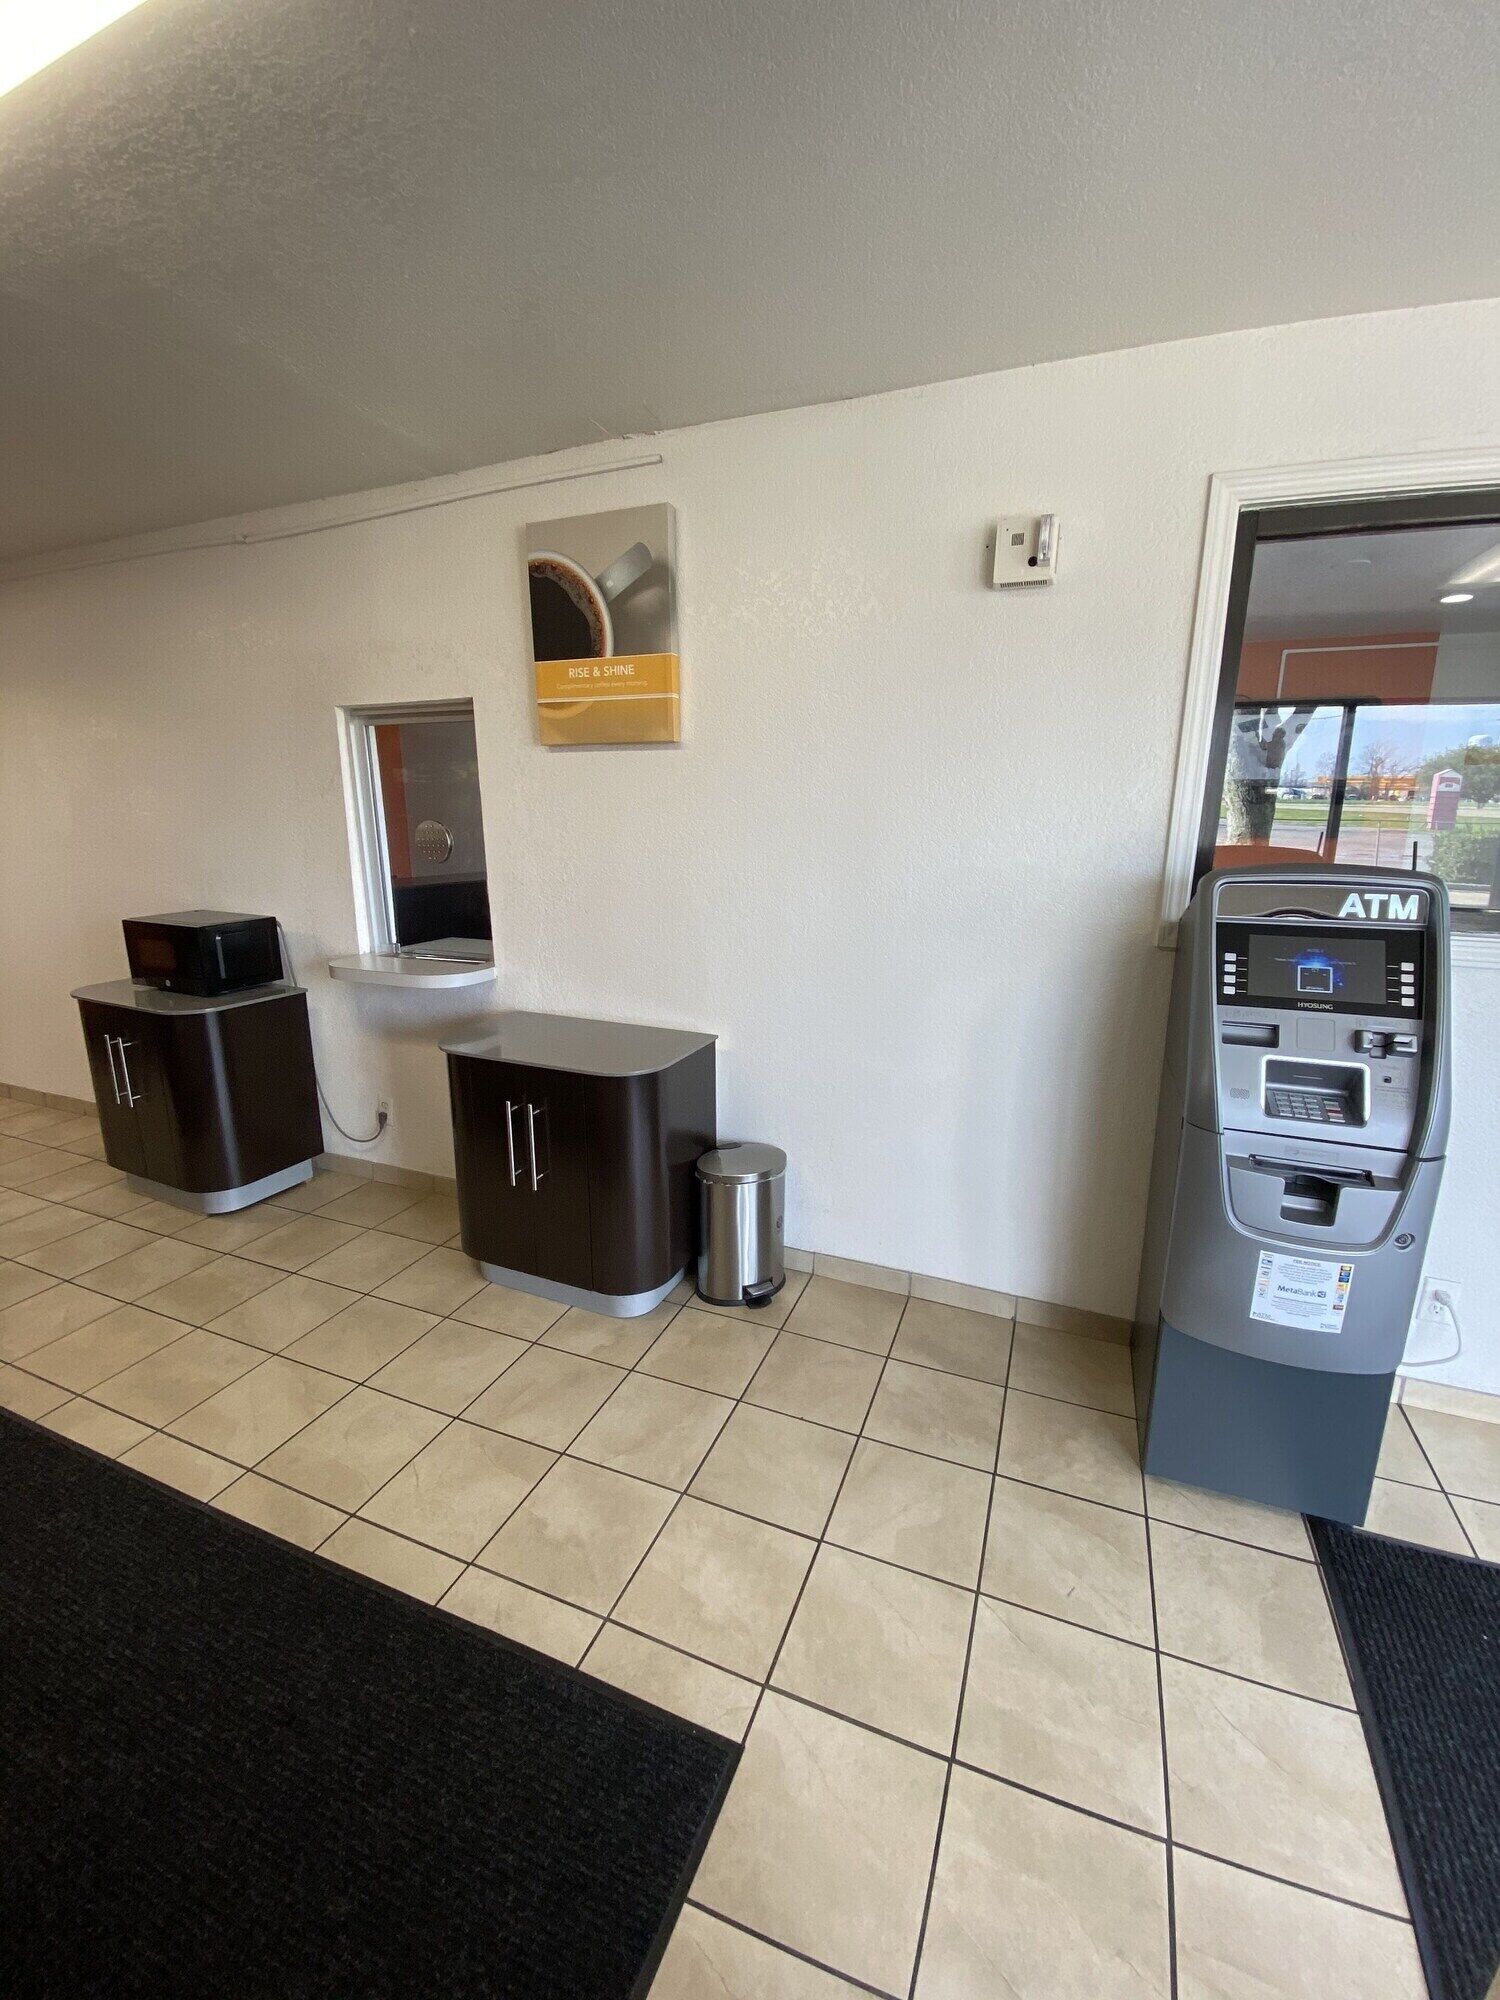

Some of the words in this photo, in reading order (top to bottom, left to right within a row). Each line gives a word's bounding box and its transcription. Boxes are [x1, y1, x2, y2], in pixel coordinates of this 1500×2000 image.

[568, 668, 590, 678] RISE
[593, 666, 601, 677] &
[603, 665, 634, 676] SHINE
[1337, 892, 1420, 920] ATM
[1297, 1001, 1334, 1011] HYOSUNG
[1277, 1285, 1317, 1298] MetaBank
